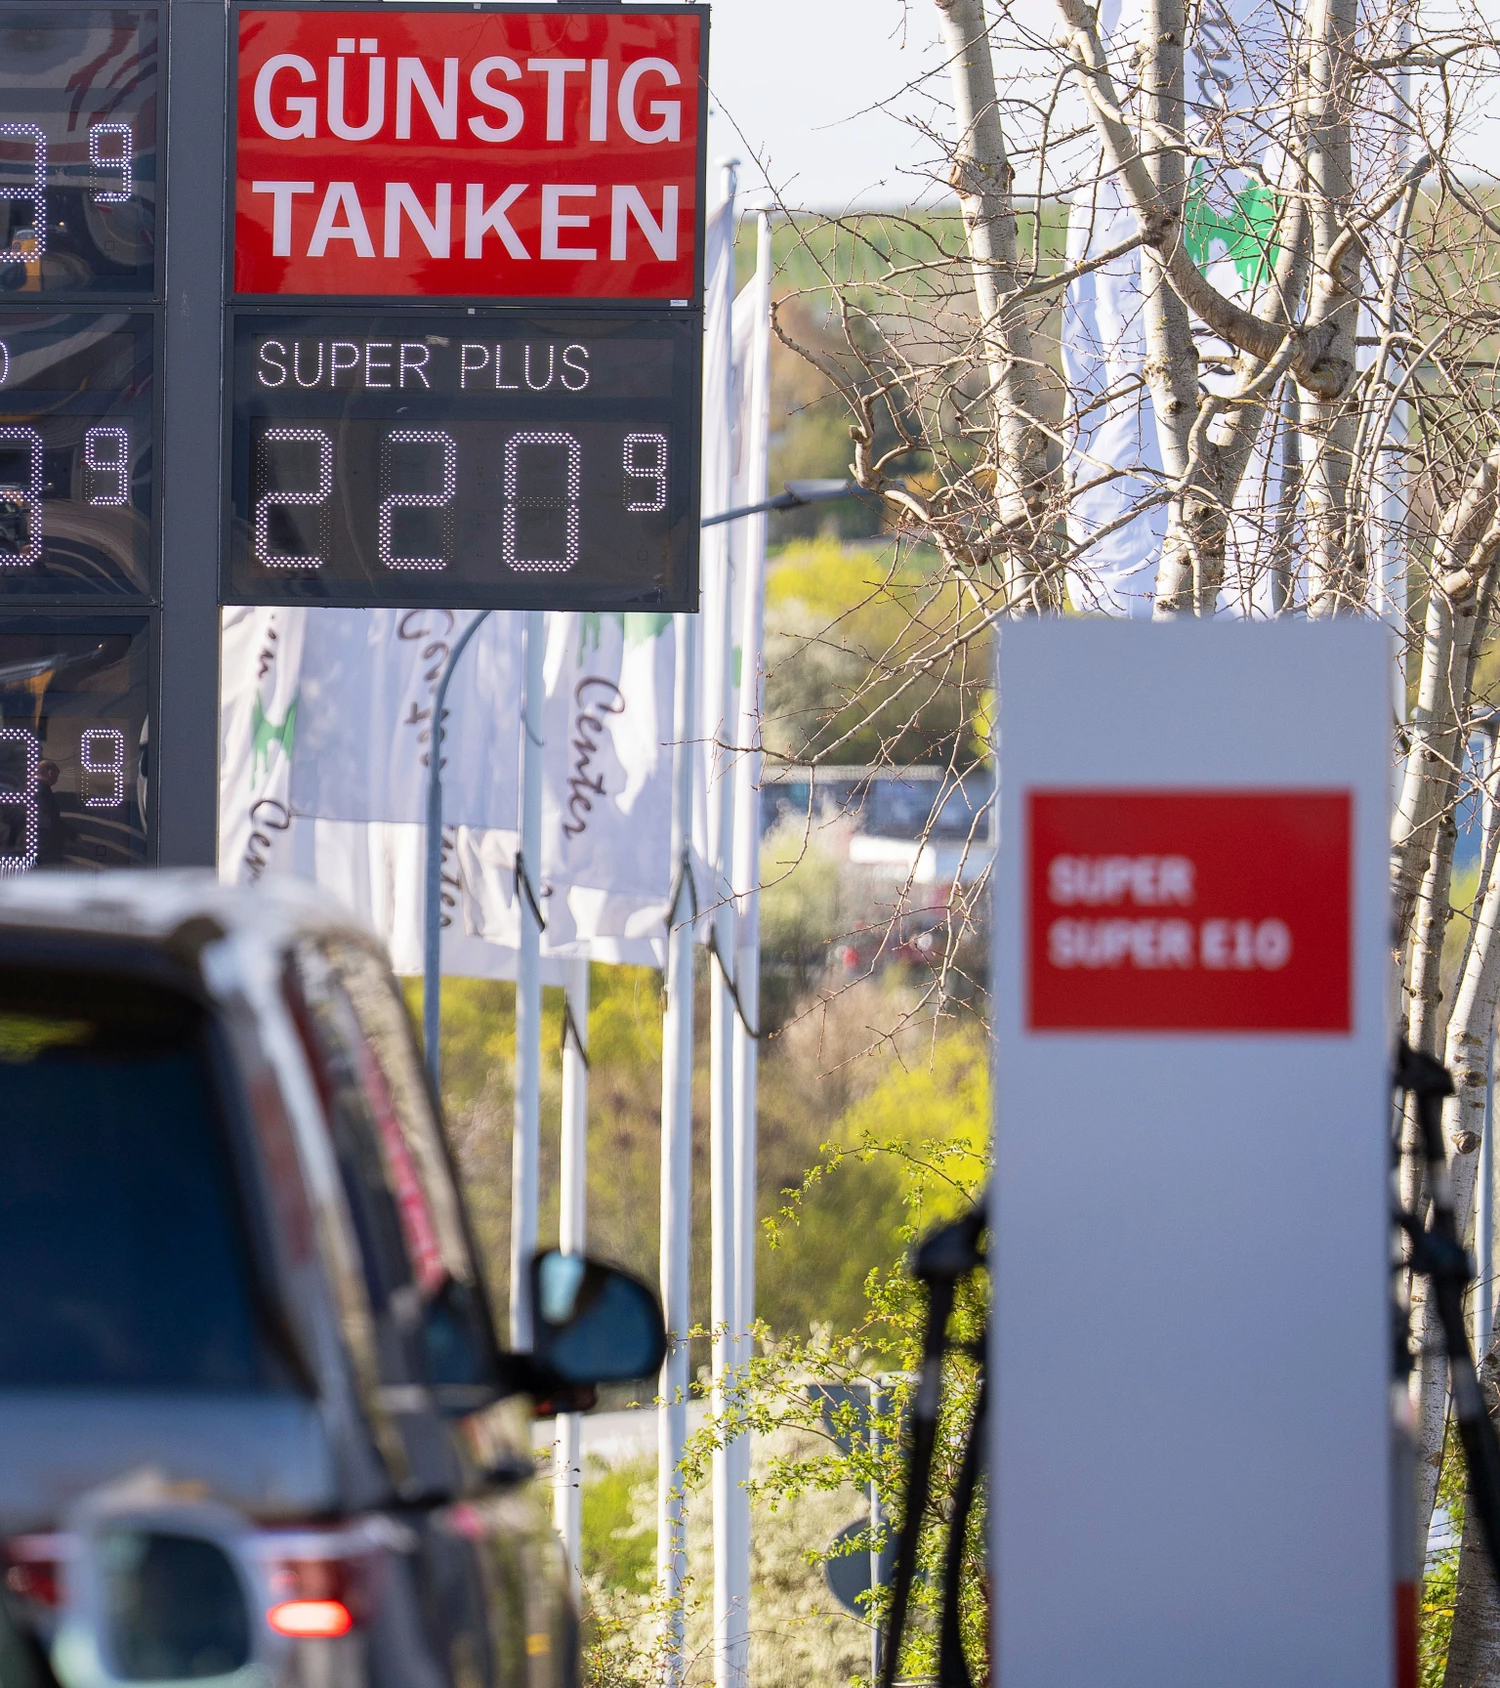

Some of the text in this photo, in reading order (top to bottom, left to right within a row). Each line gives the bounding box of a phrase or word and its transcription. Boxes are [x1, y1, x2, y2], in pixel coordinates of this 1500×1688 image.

[253, 38, 681, 144] GÜNSTIG
[252, 181, 679, 261] TANKEN
[257, 341, 591, 391] SUPER PLUS
[563, 675, 625, 840] Center
[1049, 854, 1197, 906] SUPER
[1049, 917, 1293, 972] SUPER E10
